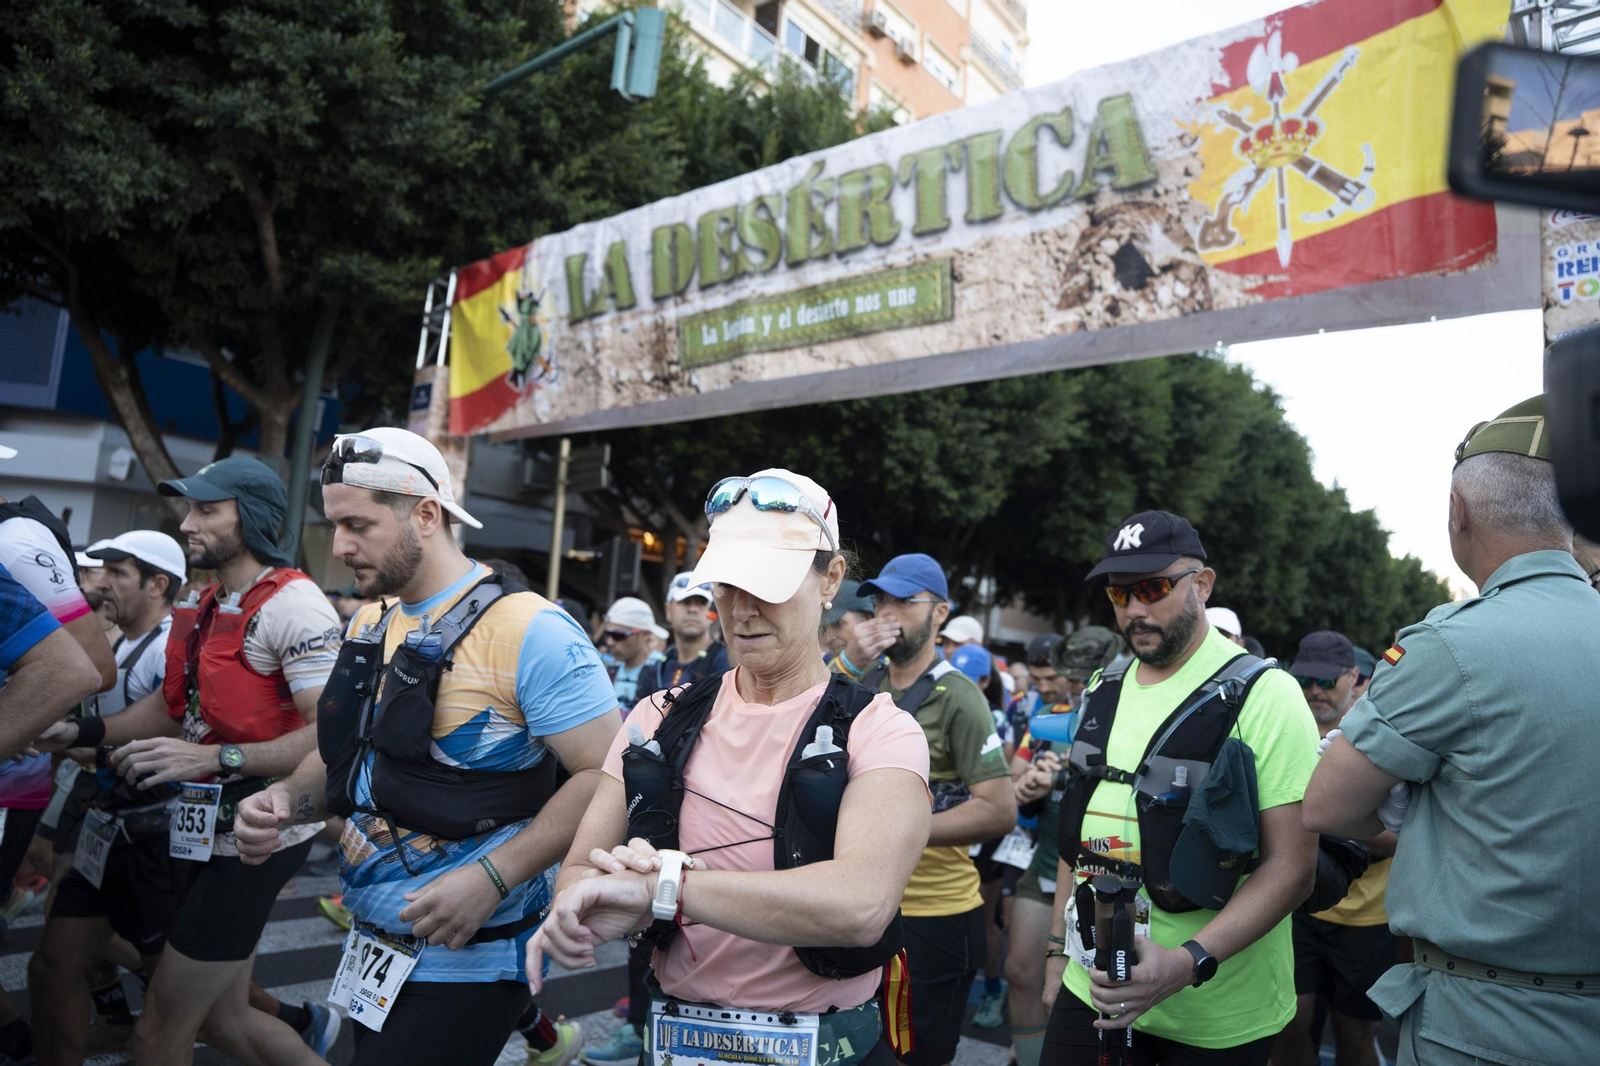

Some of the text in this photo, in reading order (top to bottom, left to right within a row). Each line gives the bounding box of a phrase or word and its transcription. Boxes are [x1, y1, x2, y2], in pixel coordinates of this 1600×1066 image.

[565, 92, 1159, 326] LA DESÉRTICA
[701, 323, 718, 346] La
[762, 313, 773, 337] y
[778, 307, 792, 330] el
[796, 296, 849, 327] desierto
[855, 291, 881, 315] nos
[887, 285, 917, 309] une
[394, 666, 419, 685] KIPRUN
[1088, 837, 1110, 854] LOS
[682, 1028, 800, 1057] LA DESÉRTICA
[801, 1037, 810, 1058] 2025
